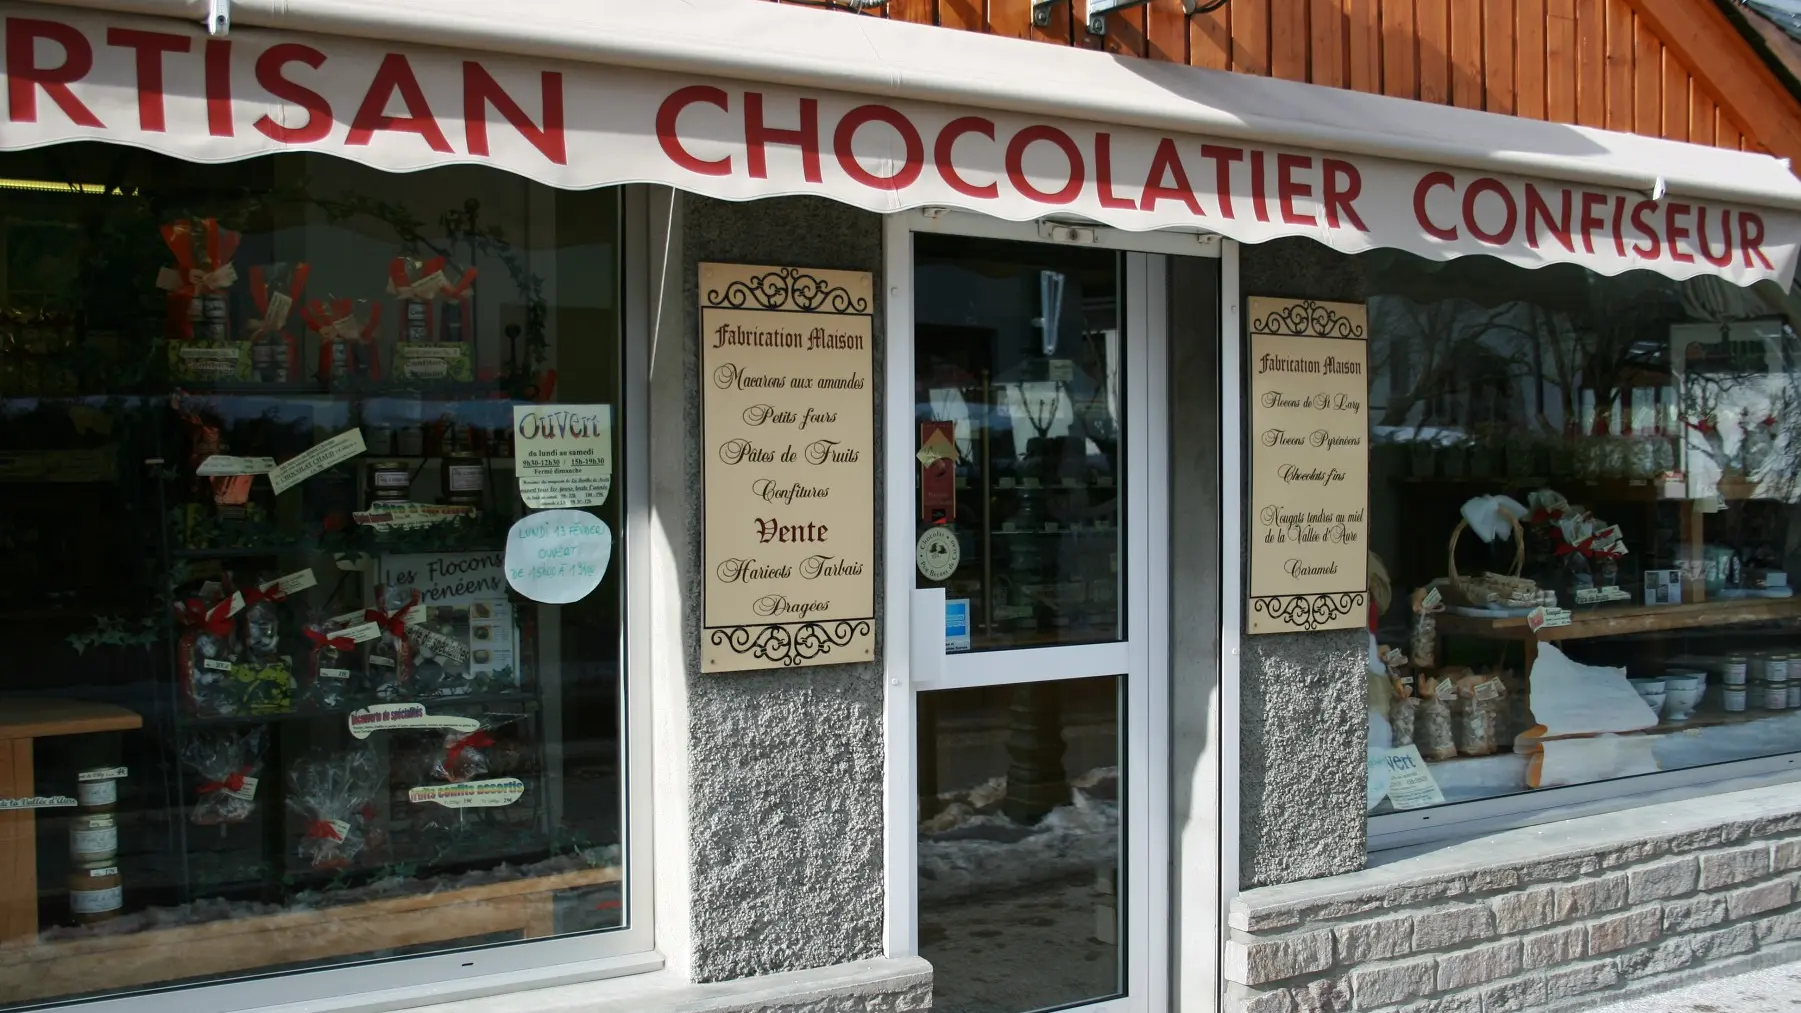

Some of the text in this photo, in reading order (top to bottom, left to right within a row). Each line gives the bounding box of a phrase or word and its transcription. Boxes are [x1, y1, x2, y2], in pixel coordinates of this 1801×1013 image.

[656, 85, 1370, 232] CHOCOLATIER
[1413, 171, 1774, 270] CONFISEUR
[713, 323, 864, 351] Fabrication Maison
[714, 362, 865, 390] Macarons aux amandes
[1258, 353, 1362, 375] Fabrication Maison
[1261, 391, 1361, 414] Flocons de St Lary
[519, 411, 600, 439] Ouvert
[743, 404, 838, 430] Petits fours
[1261, 428, 1361, 450] Flocons Pyrénéens
[522, 459, 560, 467] 9h30-12h30
[570, 457, 605, 466] 15h-19h30
[538, 449, 558, 457] lundi
[568, 448, 594, 456] samedi
[719, 438, 860, 465] Pâtes de Fruits
[553, 467, 582, 475] dimanche
[1277, 463, 1347, 486] Chocolats fins
[752, 478, 830, 505] Confitures
[1260, 504, 1364, 530] Nougats tendres au miel
[754, 517, 829, 543] Vente
[1264, 523, 1358, 545] de la Vallée d'Aure
[386, 554, 505, 587] Les Flocons
[717, 554, 864, 583] Haricots Tarbais
[1283, 558, 1338, 580] Caramels
[753, 594, 831, 619] Dragées
[383, 710, 391, 720] de
[391, 706, 423, 720] spécialités
[1386, 753, 1416, 771] vert
[410, 780, 524, 801] fruits confits assortis
